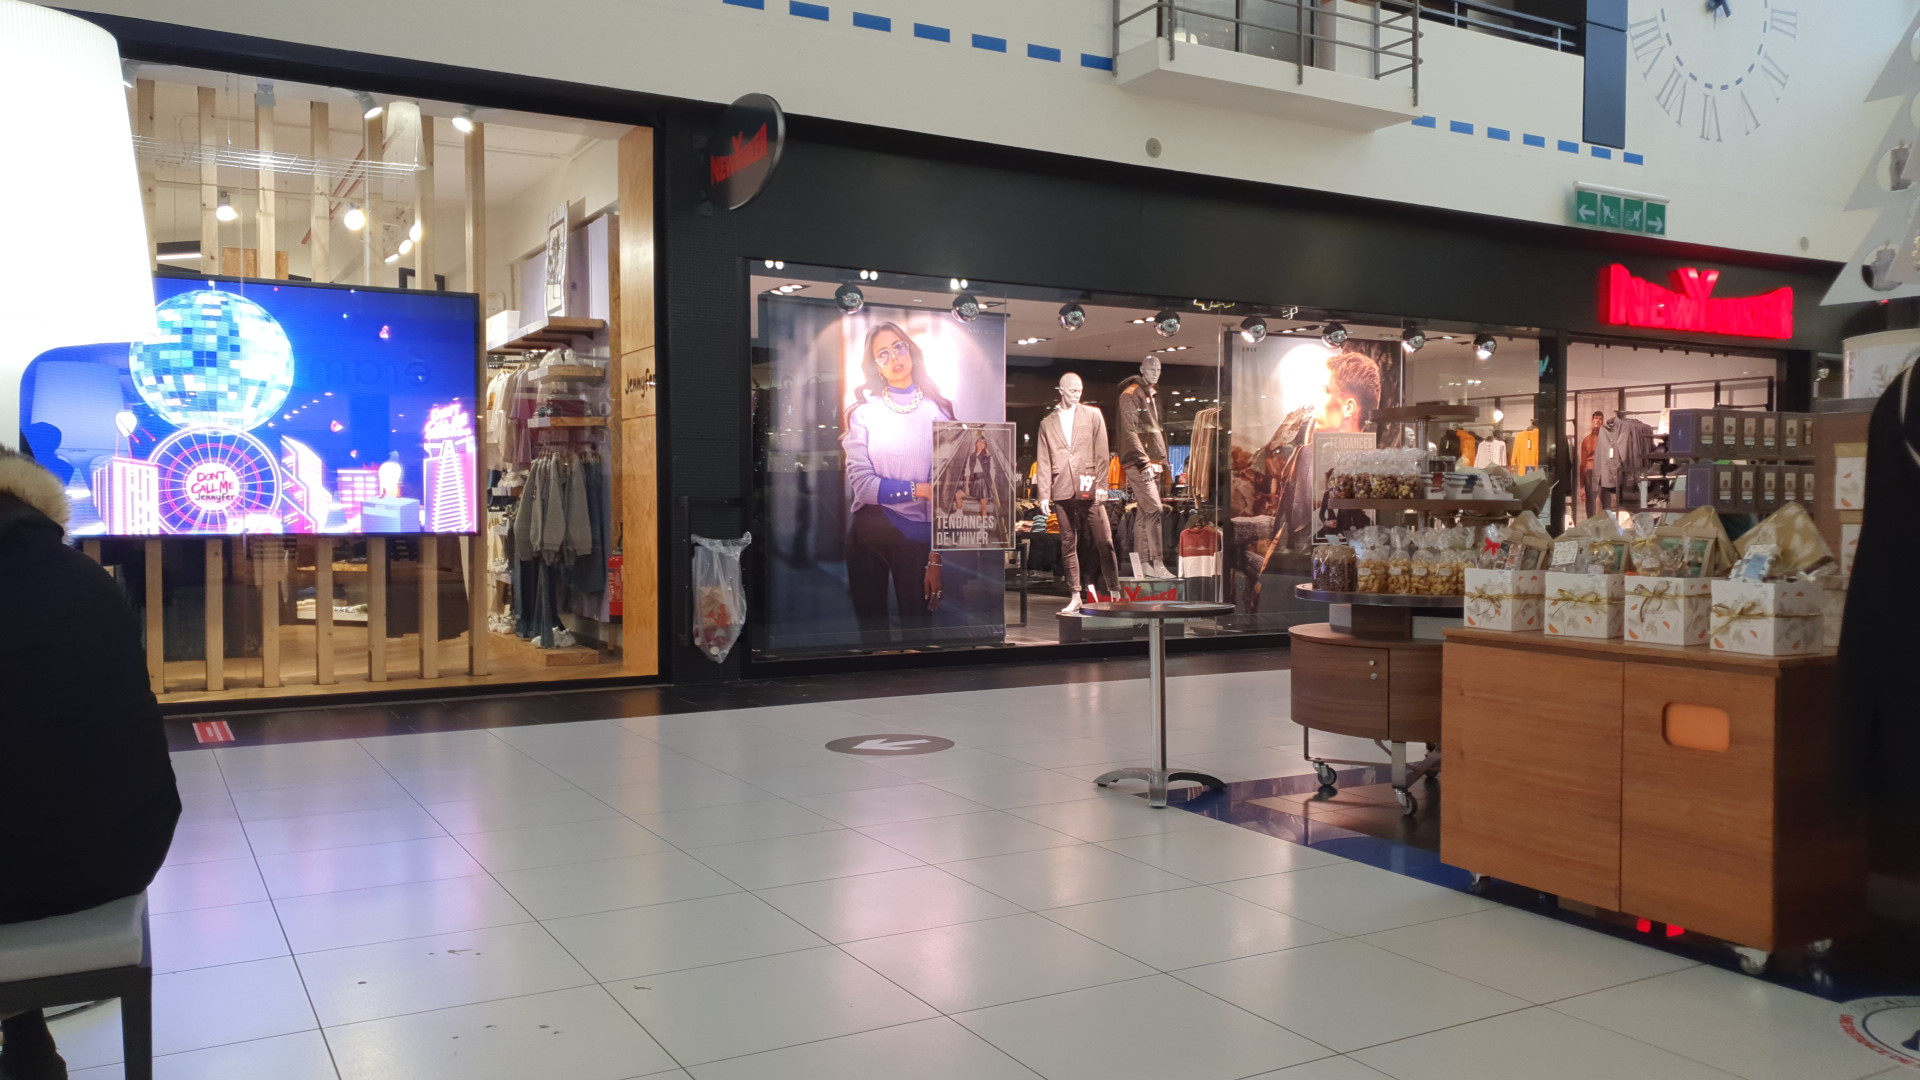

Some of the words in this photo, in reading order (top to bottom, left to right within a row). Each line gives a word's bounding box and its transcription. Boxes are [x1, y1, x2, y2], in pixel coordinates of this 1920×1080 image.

[191, 482, 218, 494] CALL
[219, 481, 234, 494] ME
[195, 493, 236, 503] Jennyfer
[936, 515, 994, 529] TENDANCES
[936, 531, 949, 545] DE
[952, 531, 989, 545] L'HIVER
